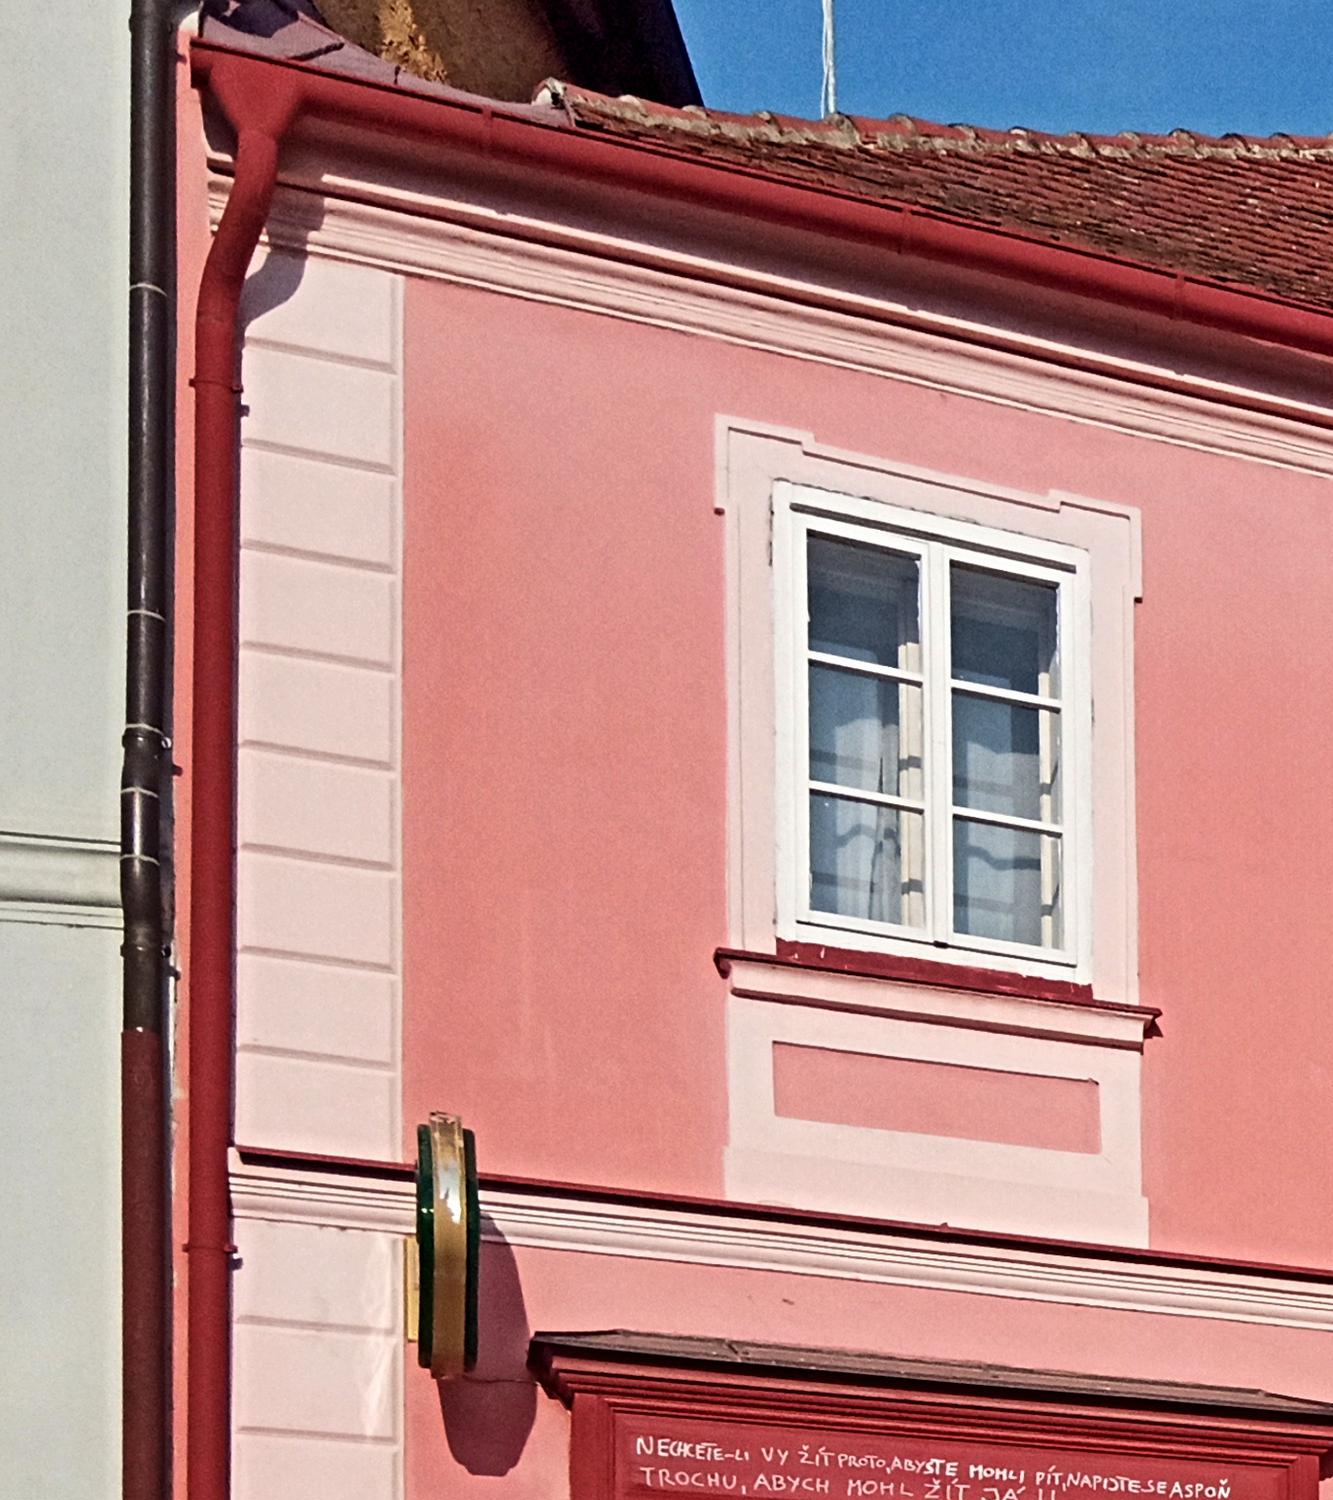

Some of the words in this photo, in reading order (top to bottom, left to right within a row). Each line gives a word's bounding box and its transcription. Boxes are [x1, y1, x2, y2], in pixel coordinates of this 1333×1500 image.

[753, 1474, 829, 1493] ABYCH
[847, 1479, 913, 1498] MOHL
[762, 1447, 788, 1465] VY
[969, 1464, 1025, 1484] MOHLI
[1169, 1478, 1231, 1500] ASPOŇ
